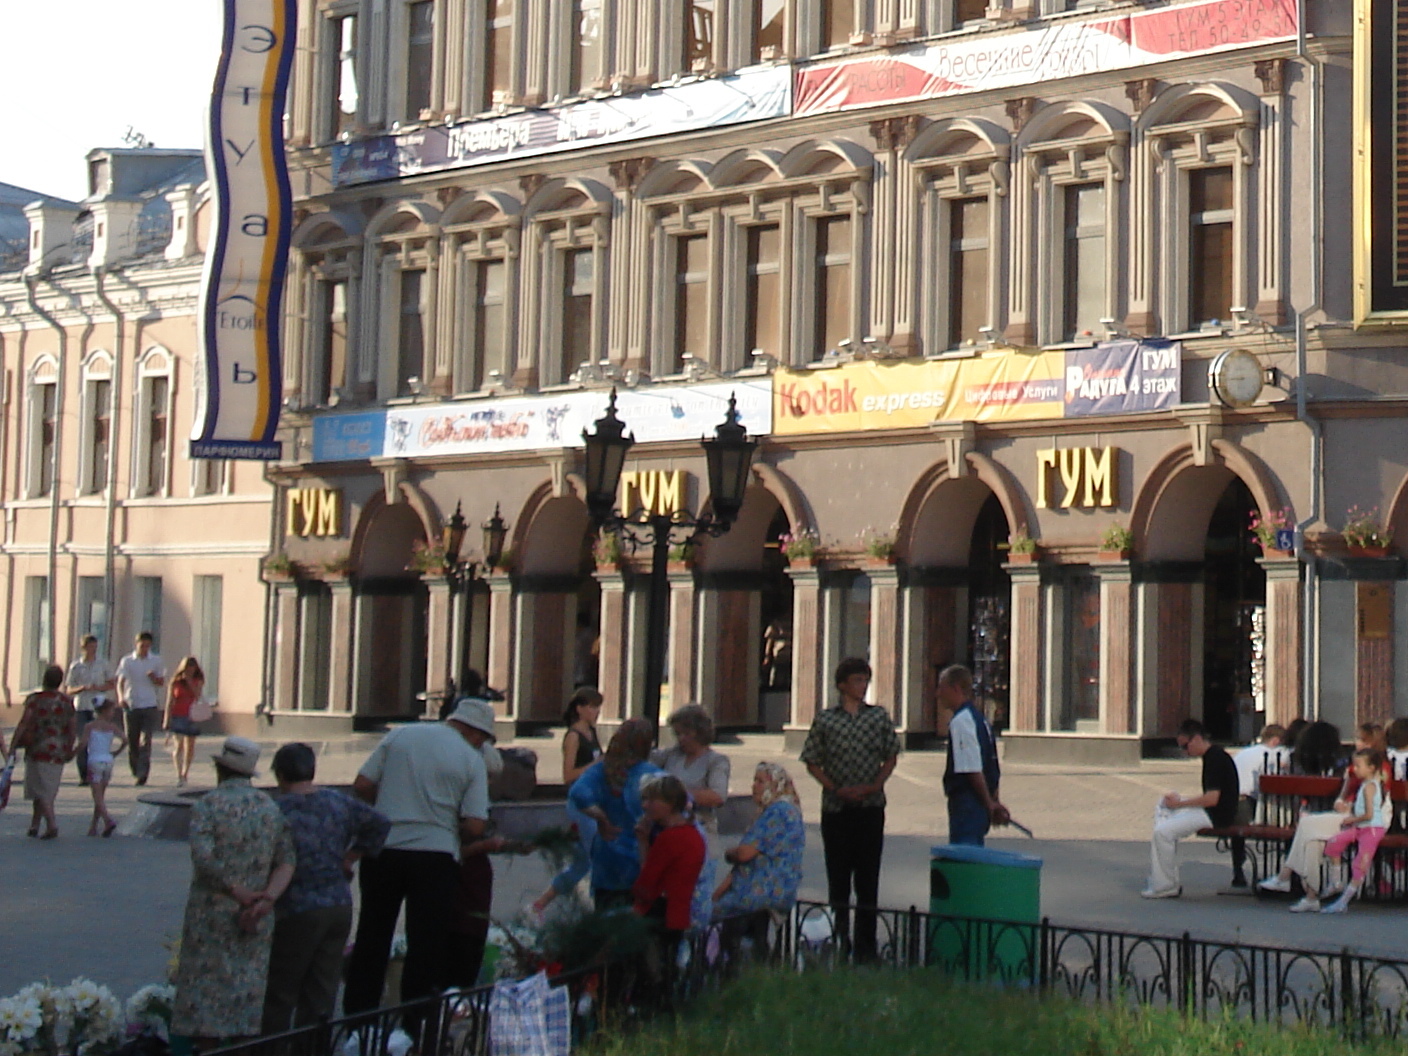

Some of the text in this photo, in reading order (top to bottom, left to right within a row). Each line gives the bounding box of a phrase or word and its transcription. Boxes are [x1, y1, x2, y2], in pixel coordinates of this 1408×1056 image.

[1175, 7, 1211, 33] ГУМ
[1217, 2, 1228, 24] 5
[446, 119, 532, 161] Премьера
[1142, 349, 1178, 371] ГУМ
[780, 378, 946, 418] Kodak express
[1022, 384, 1059, 401] Услуги
[1129, 376, 1178, 395] 4 этаж
[621, 469, 680, 522] ГУМ
[1036, 445, 1112, 509] ГУМ
[286, 487, 337, 537] ГУМ
